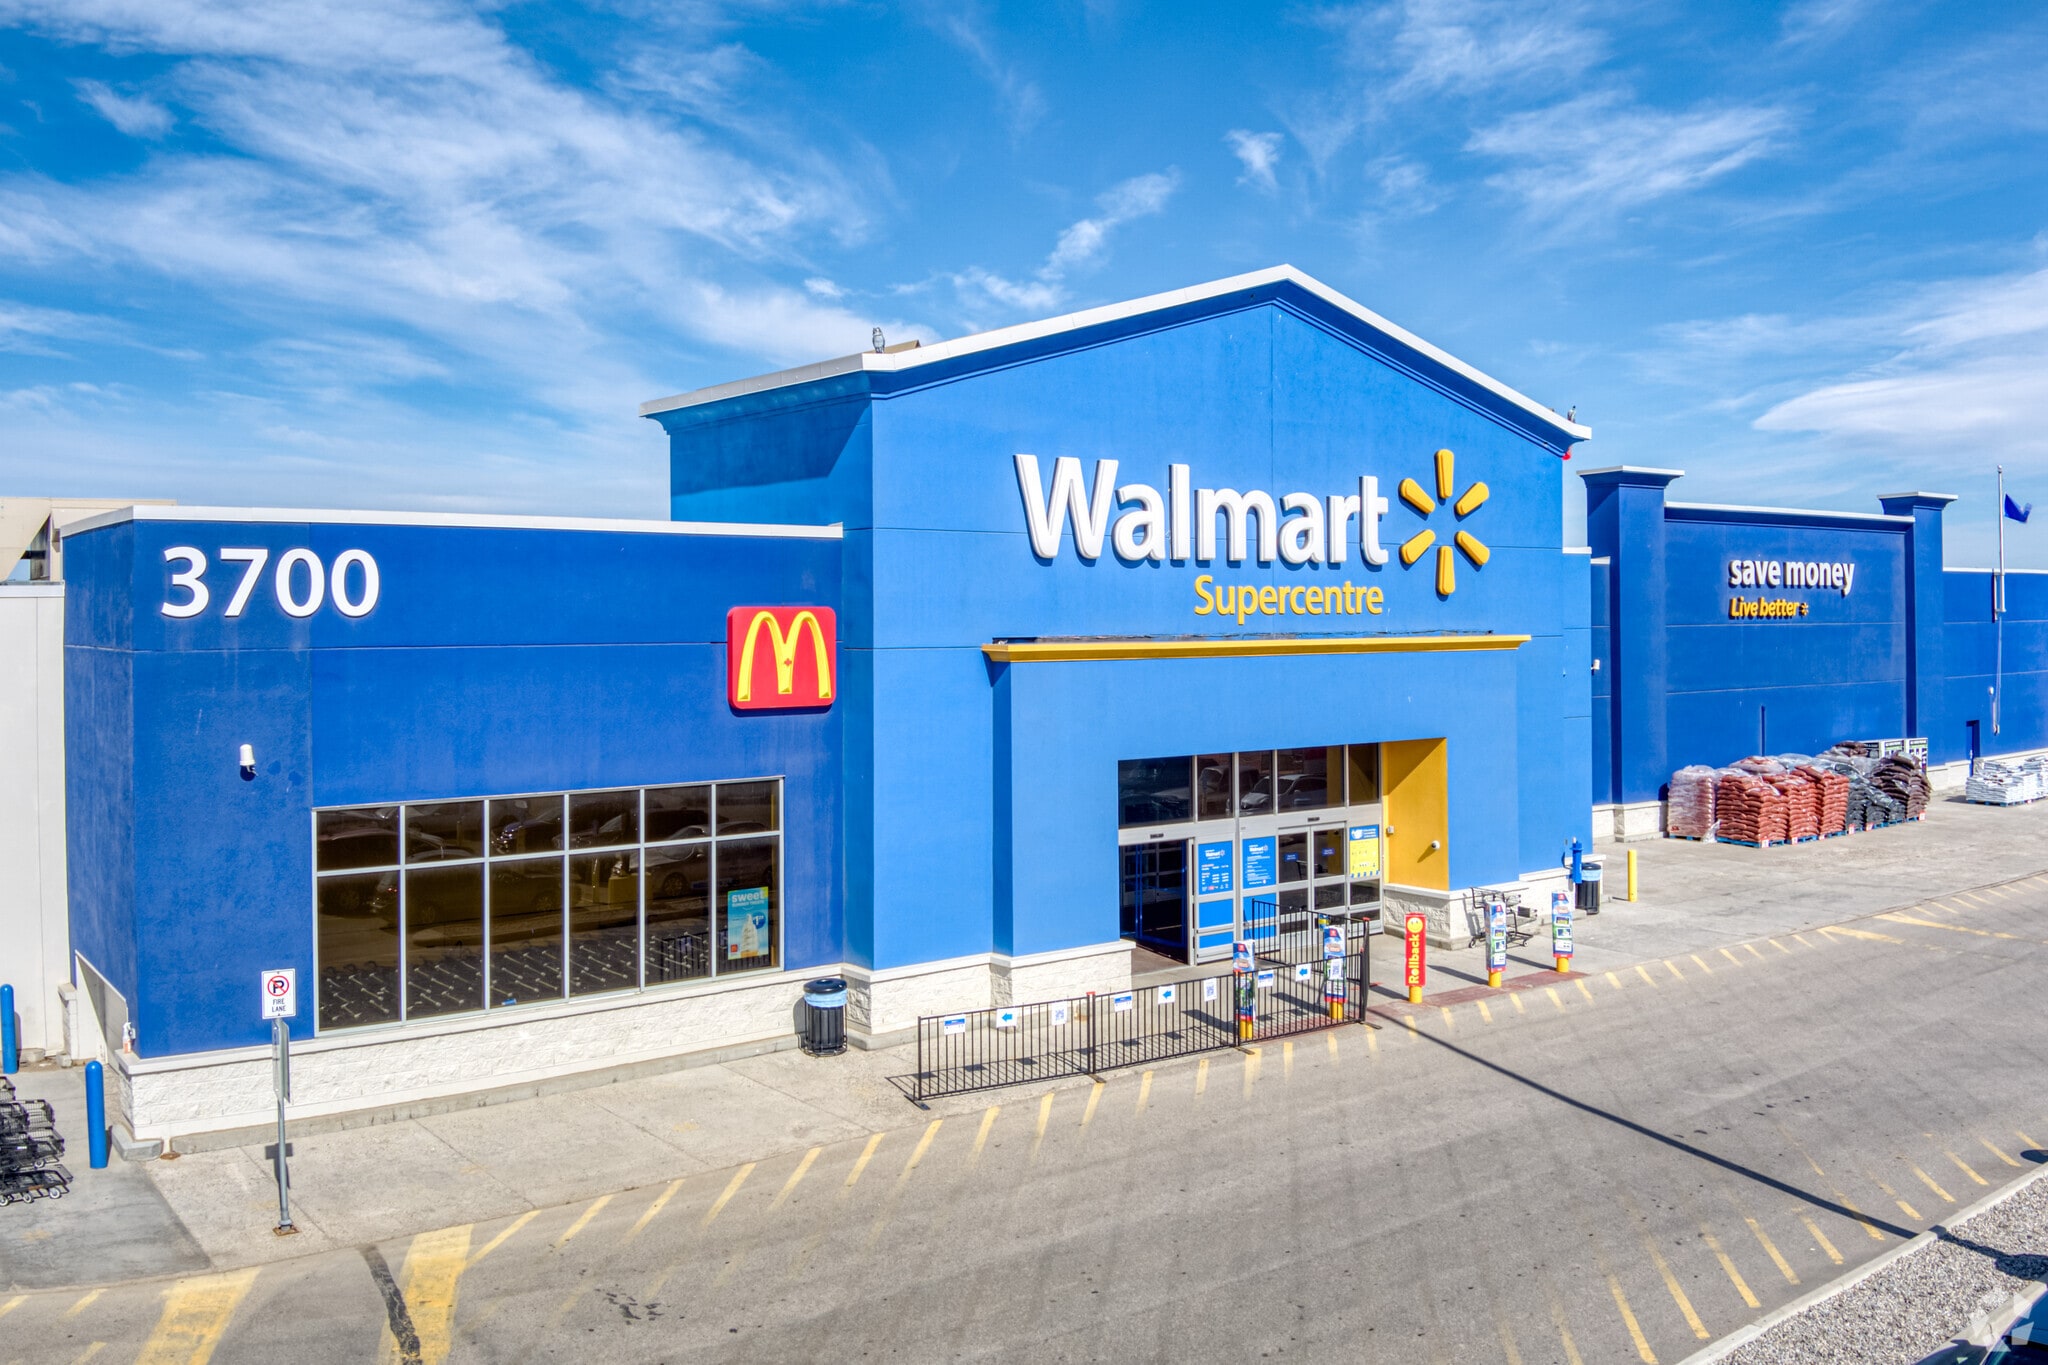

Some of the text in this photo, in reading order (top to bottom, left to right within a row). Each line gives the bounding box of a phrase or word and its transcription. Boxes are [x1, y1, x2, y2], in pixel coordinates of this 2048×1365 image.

[1014, 454, 1389, 565] Walmart
[161, 546, 379, 618] 3700
[1194, 574, 1384, 625] Supercentre
[1729, 559, 1855, 597] save money
[1730, 596, 1799, 618] Live better
[731, 890, 764, 902] sweet
[1408, 934, 1420, 984] Rollback
[271, 1005, 286, 1013] LANE
